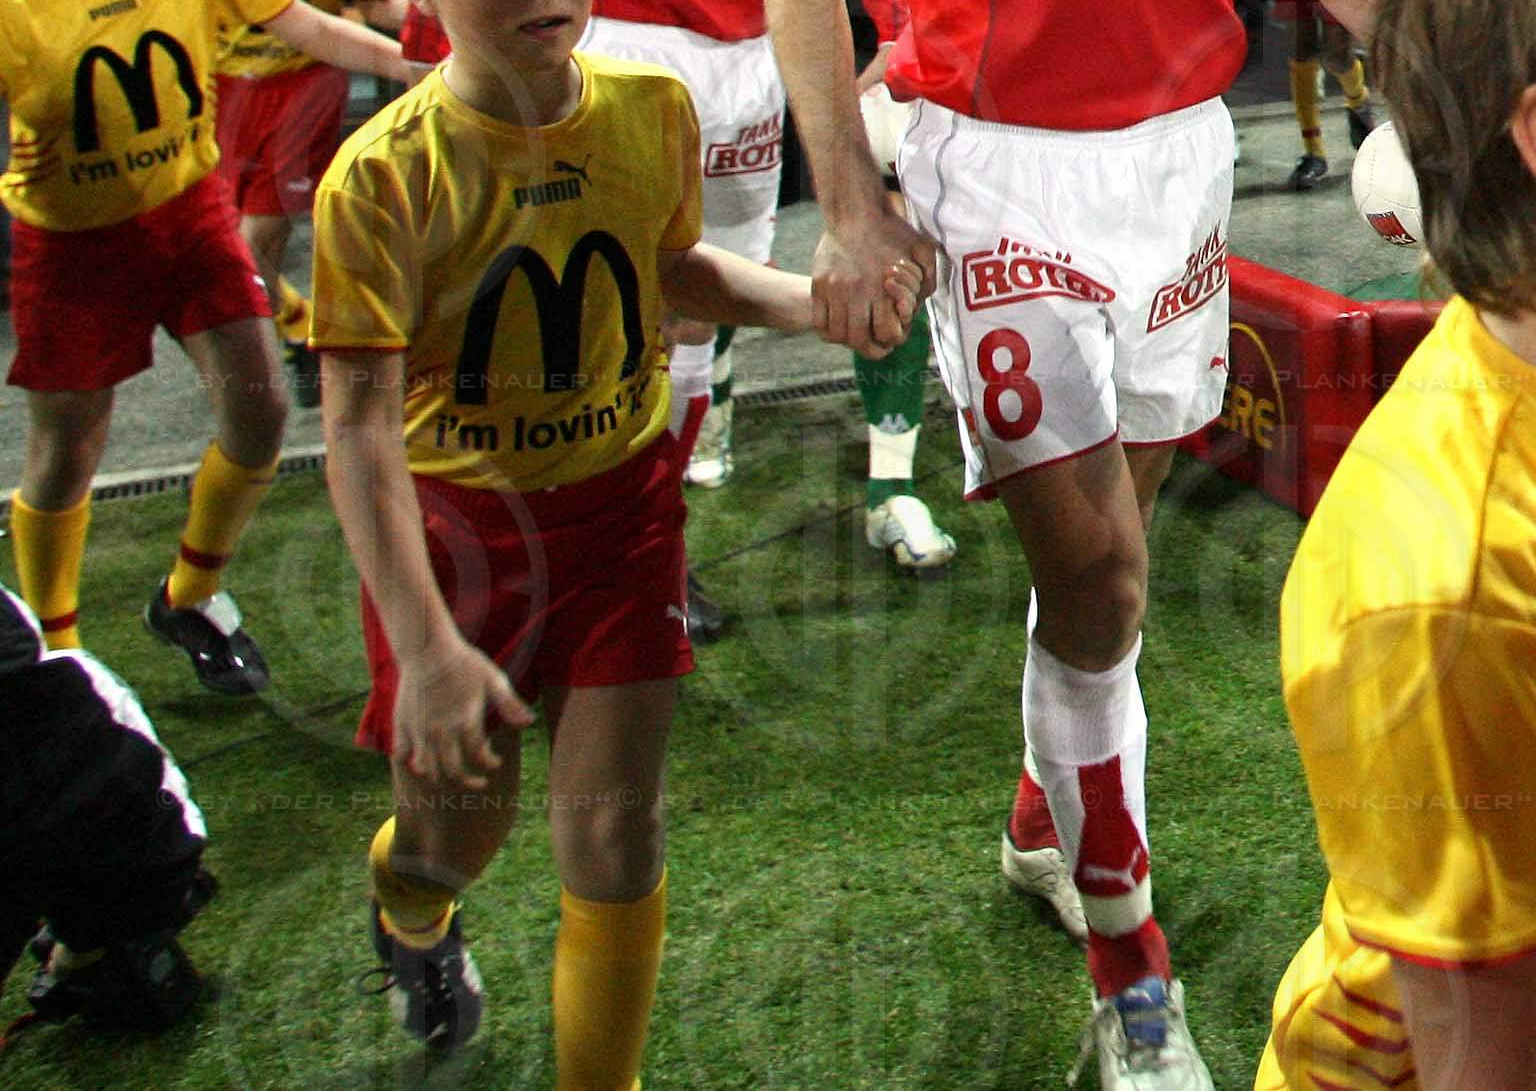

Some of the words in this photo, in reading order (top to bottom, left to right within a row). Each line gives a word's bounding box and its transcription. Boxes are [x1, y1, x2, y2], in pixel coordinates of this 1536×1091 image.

[716, 140, 781, 170] ROT
[977, 328, 1043, 441] 8
[436, 414, 499, 451] i'm
[513, 393, 622, 451] lovin'
